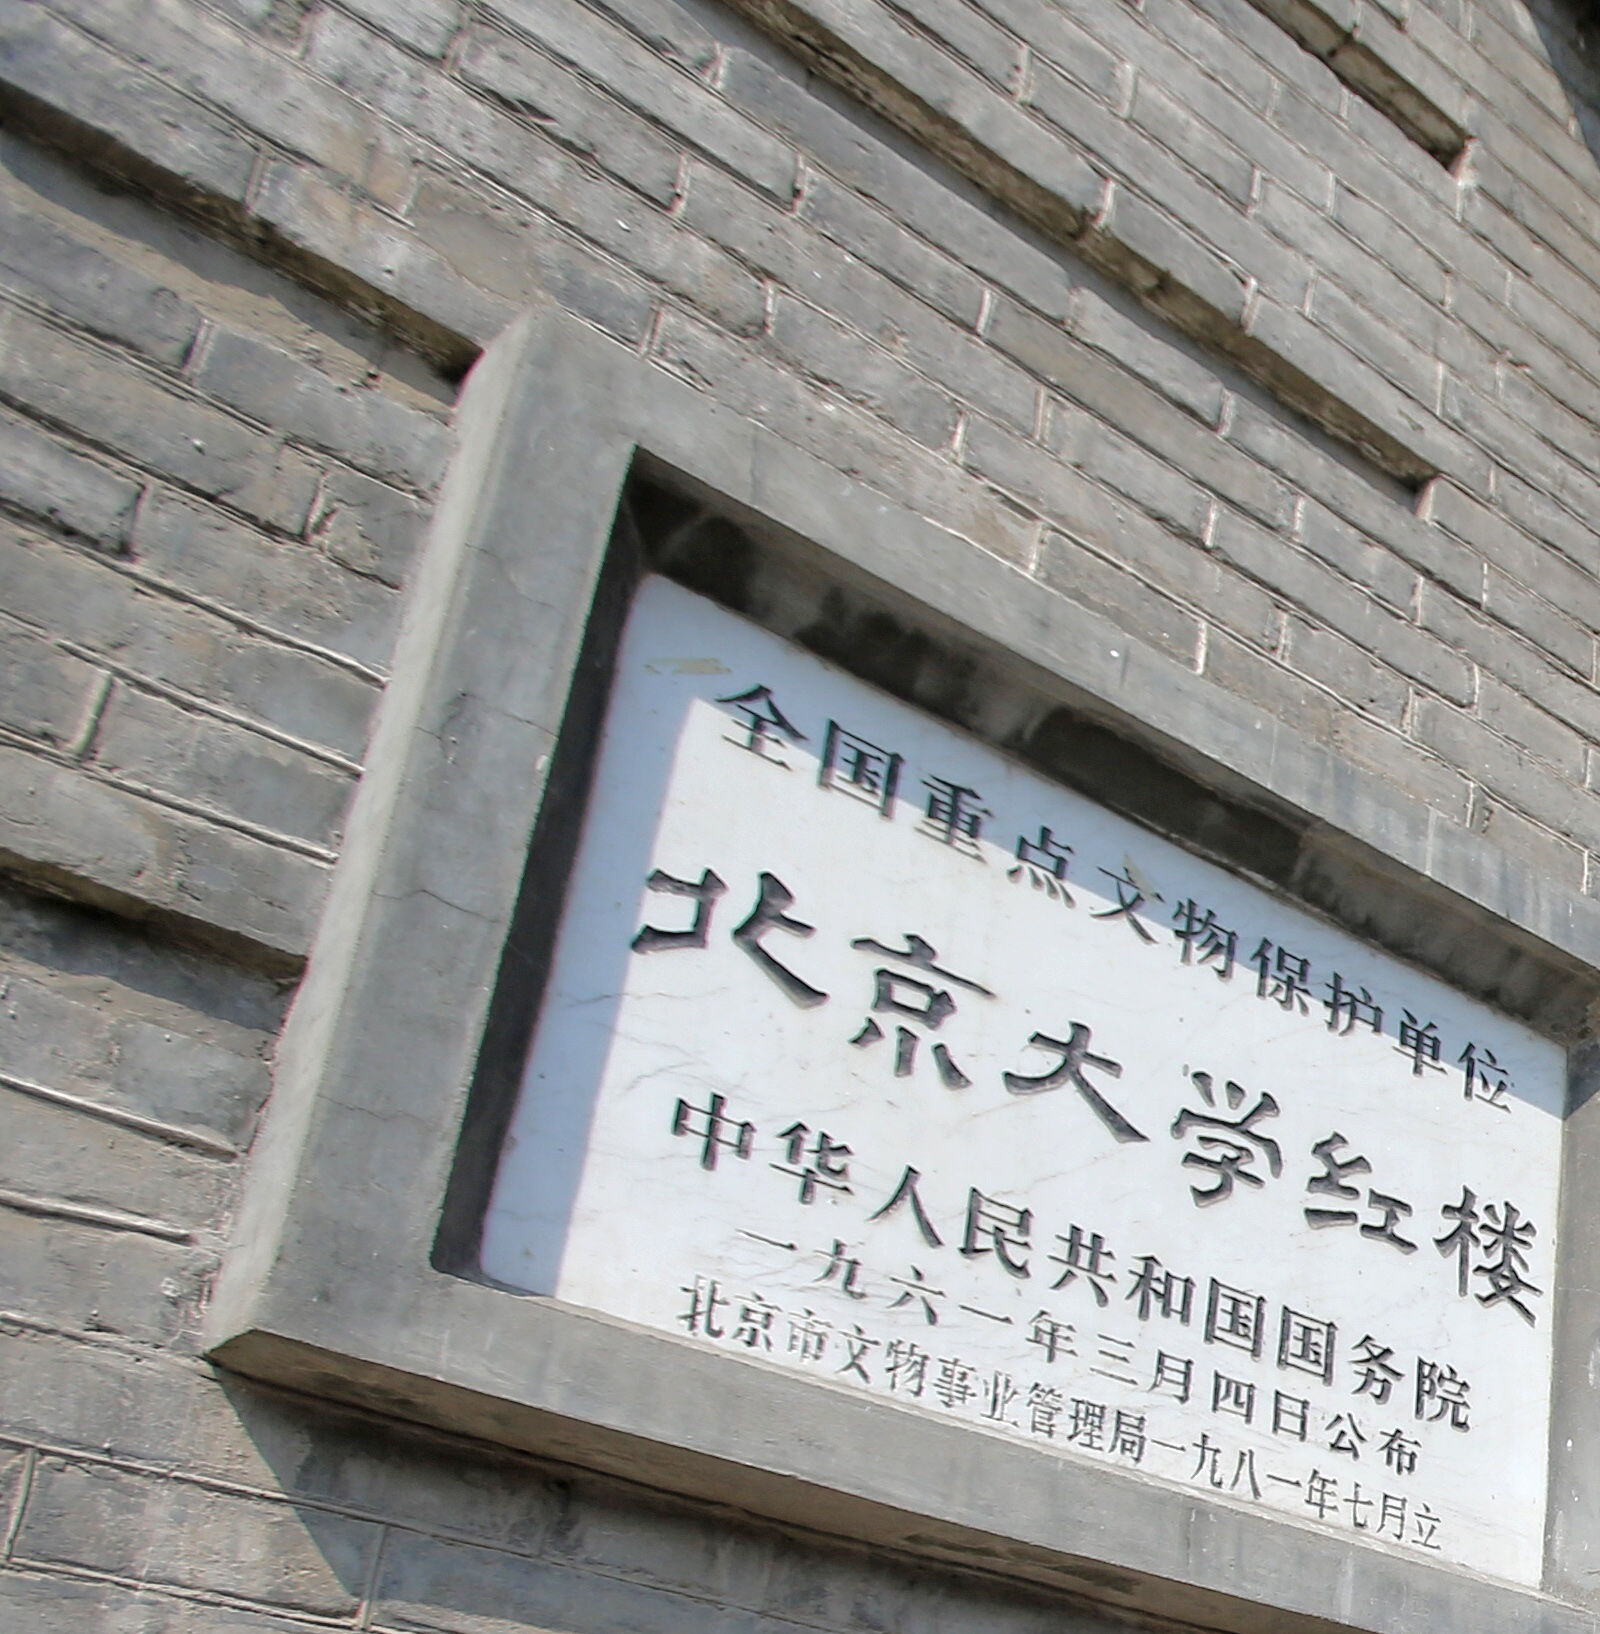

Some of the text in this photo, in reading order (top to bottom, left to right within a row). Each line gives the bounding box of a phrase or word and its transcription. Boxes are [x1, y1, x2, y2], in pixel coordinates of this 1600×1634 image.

[716, 683, 1514, 1115] 全国重点文物保护单位
[631, 867, 1544, 1326] 北京大学红楼
[672, 1091, 1472, 1432] 中华人民共和国国务院
[735, 1228, 1422, 1476] 一九六一年三月四日公布
